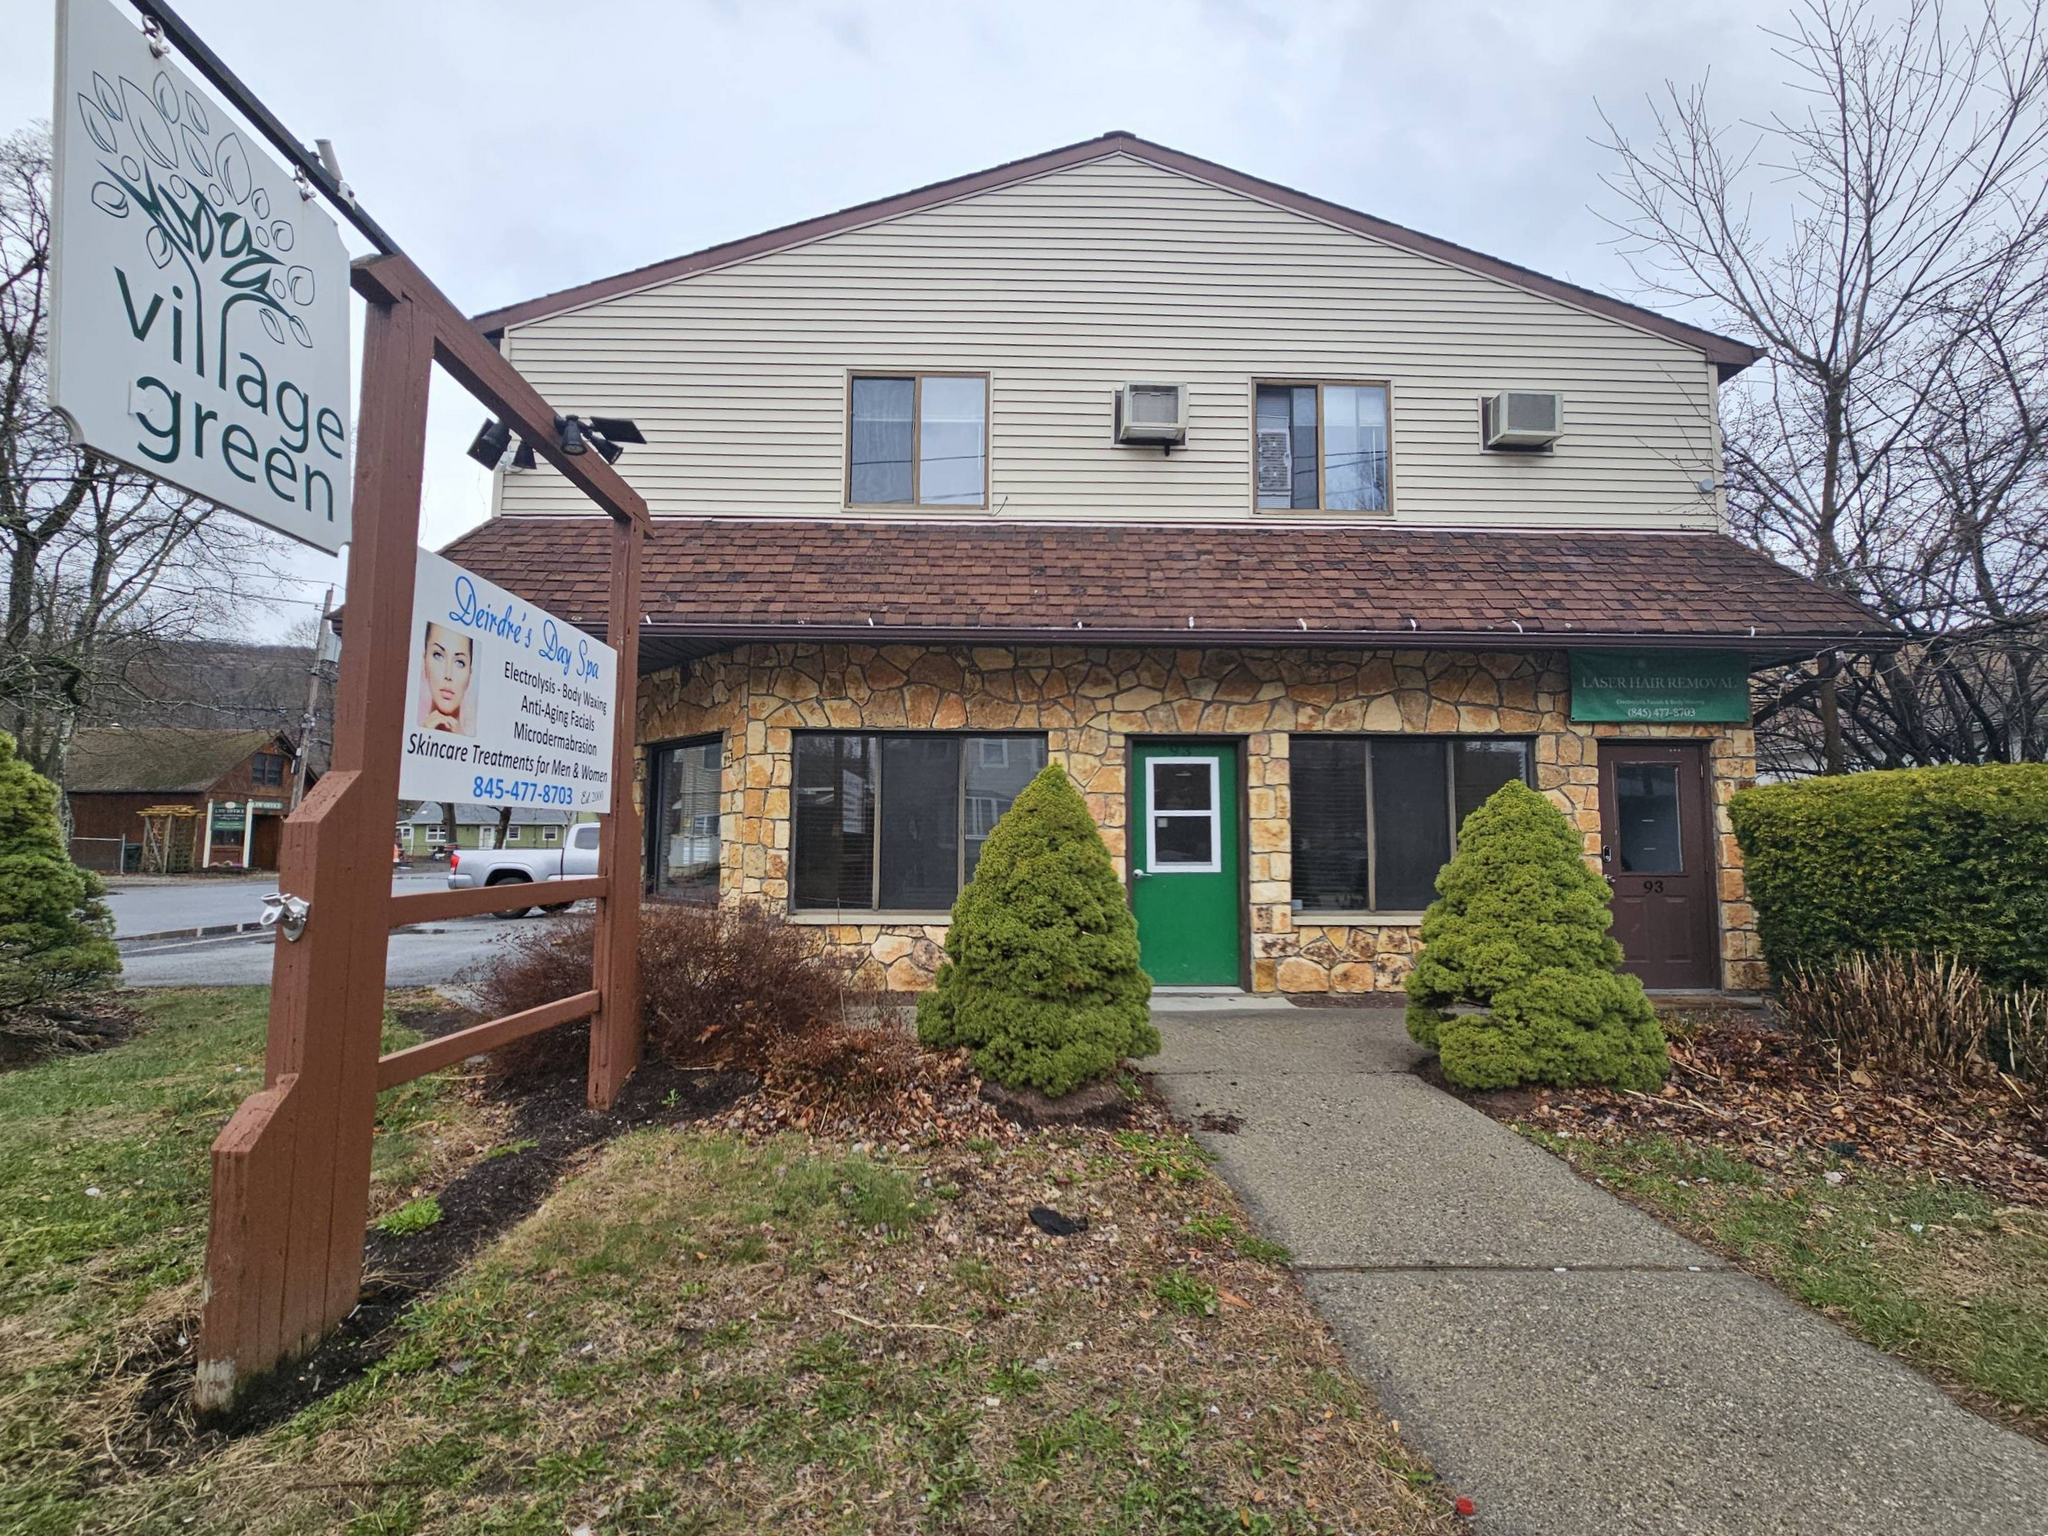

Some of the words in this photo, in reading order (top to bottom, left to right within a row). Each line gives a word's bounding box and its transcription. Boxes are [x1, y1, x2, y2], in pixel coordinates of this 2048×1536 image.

[114, 266, 345, 459] village
[136, 376, 334, 522] green
[449, 575, 533, 648] Deirdre's
[538, 619, 572, 676] Day
[576, 639, 599, 684] Spa
[504, 661, 556, 694] Electrolysis
[562, 683, 582, 707] Body
[583, 690, 607, 715] Waxing
[1582, 676, 1627, 689] LASER
[1629, 676, 1665, 689] HAIR
[1667, 676, 1738, 689] REMOVAL
[520, 695, 569, 728] Anti-Aging
[570, 710, 595, 731] Facials
[1627, 707, 1652, 719] (845)
[1653, 707, 1696, 718] 477-8703
[513, 721, 598, 756] Microdermabrasion
[407, 733, 468, 762] Skincare
[472, 744, 534, 772] Treatments
[534, 755, 550, 777] for
[551, 759, 571, 777] Men
[572, 762, 579, 778] &
[581, 764, 608, 783] Women
[473, 776, 573, 805] 845-477-8703
[1643, 880, 1664, 894] 93
